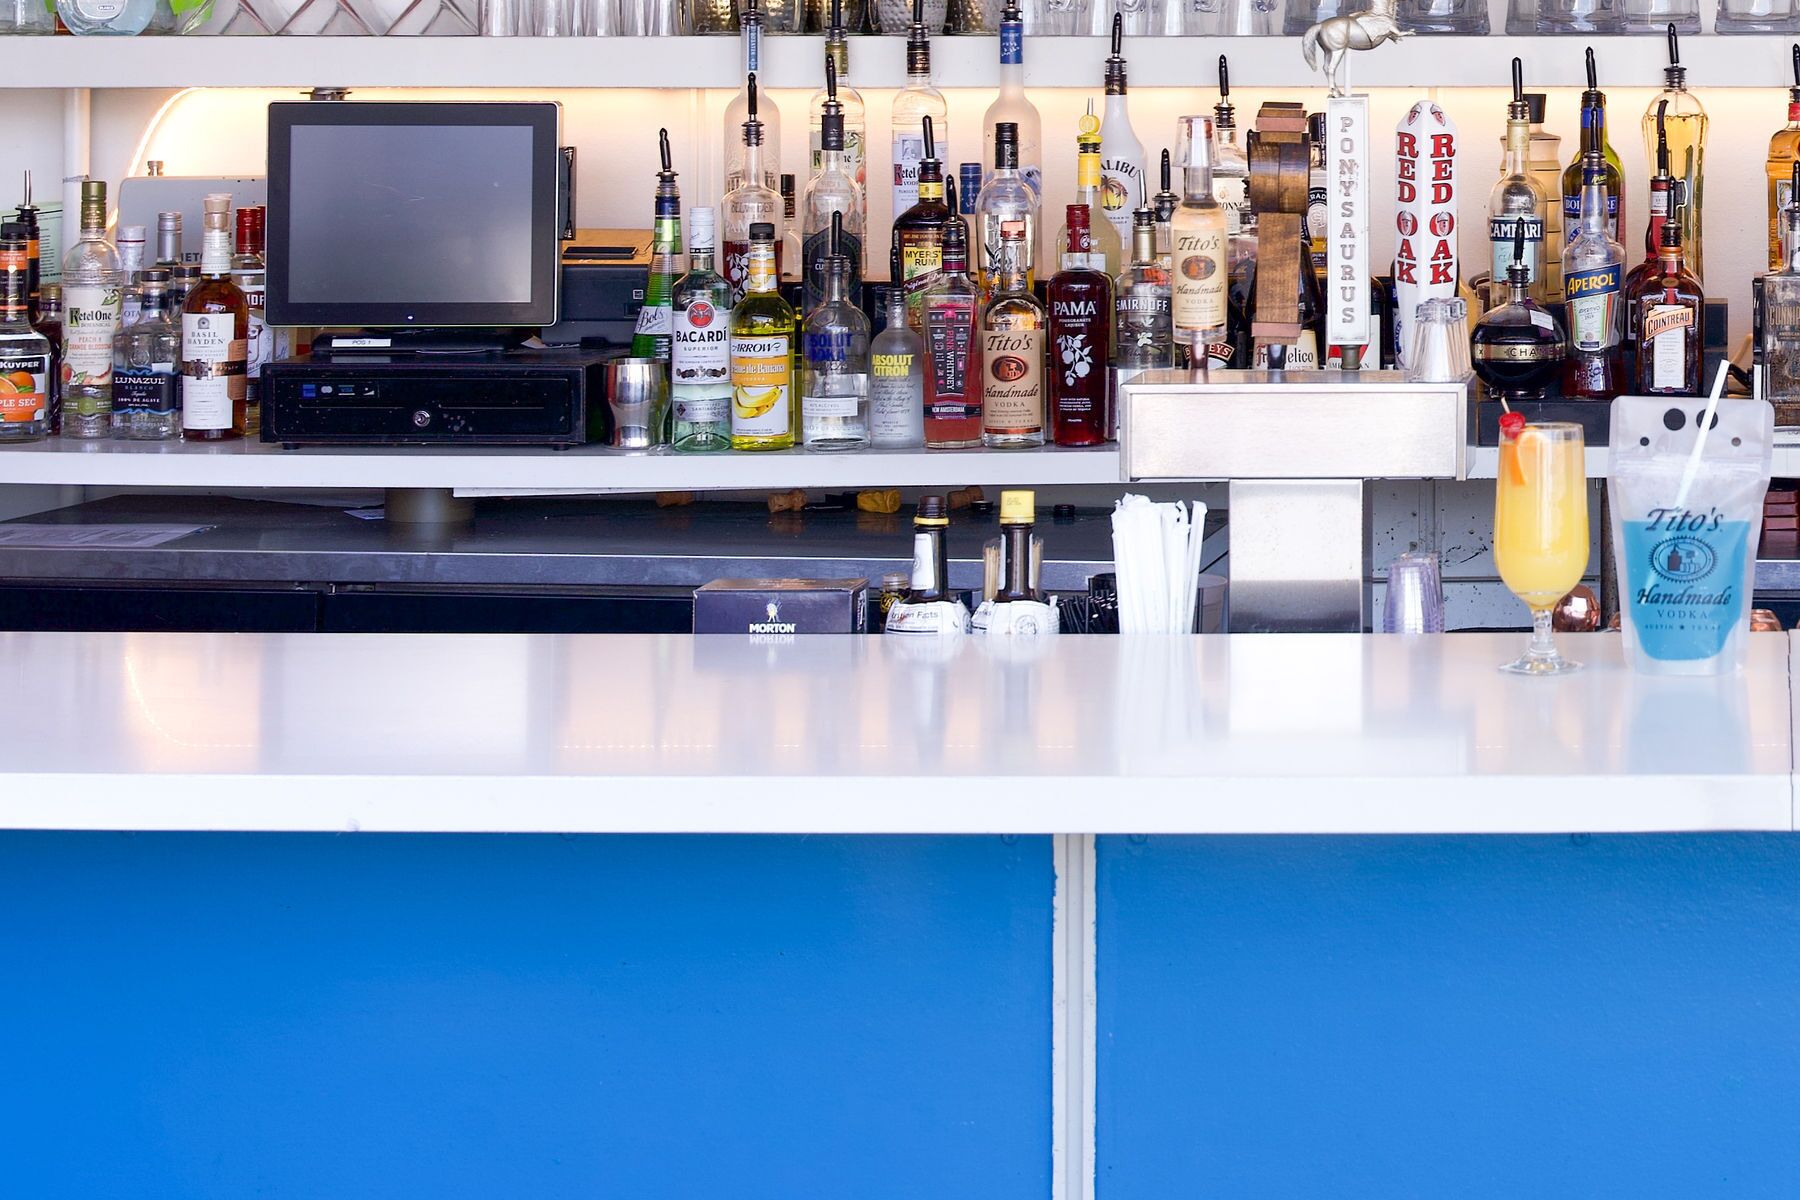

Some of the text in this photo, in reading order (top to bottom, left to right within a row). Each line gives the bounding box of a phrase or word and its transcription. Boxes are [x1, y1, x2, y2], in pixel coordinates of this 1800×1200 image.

[1430, 134, 1456, 204] RED
[1339, 116, 1359, 324] PONYSAURUS
[915, 258, 937, 267] RUM
[1568, 273, 1615, 295] APEROL
[1176, 285, 1224, 296] Handmade
[1054, 301, 1096, 315] PAMA
[1116, 300, 1169, 312] SMIRNOFF
[69, 308, 112, 327] Ketel One
[1648, 310, 1691, 336] COINTREAU
[676, 327, 727, 343] BACARDÍ
[735, 343, 774, 353] ARROW
[0, 360, 40, 369] KUYPER
[872, 354, 914, 366] ABSOLUT
[874, 365, 909, 377] CITRON
[946, 351, 955, 390] WHITNEY
[115, 377, 165, 385] LUNAZUL
[985, 384, 1039, 398] Handmade
[18, 398, 36, 407] SEC
[1637, 584, 1733, 606] Handmade
[1657, 610, 1709, 619] VODKA
[749, 623, 795, 634] MORTON
